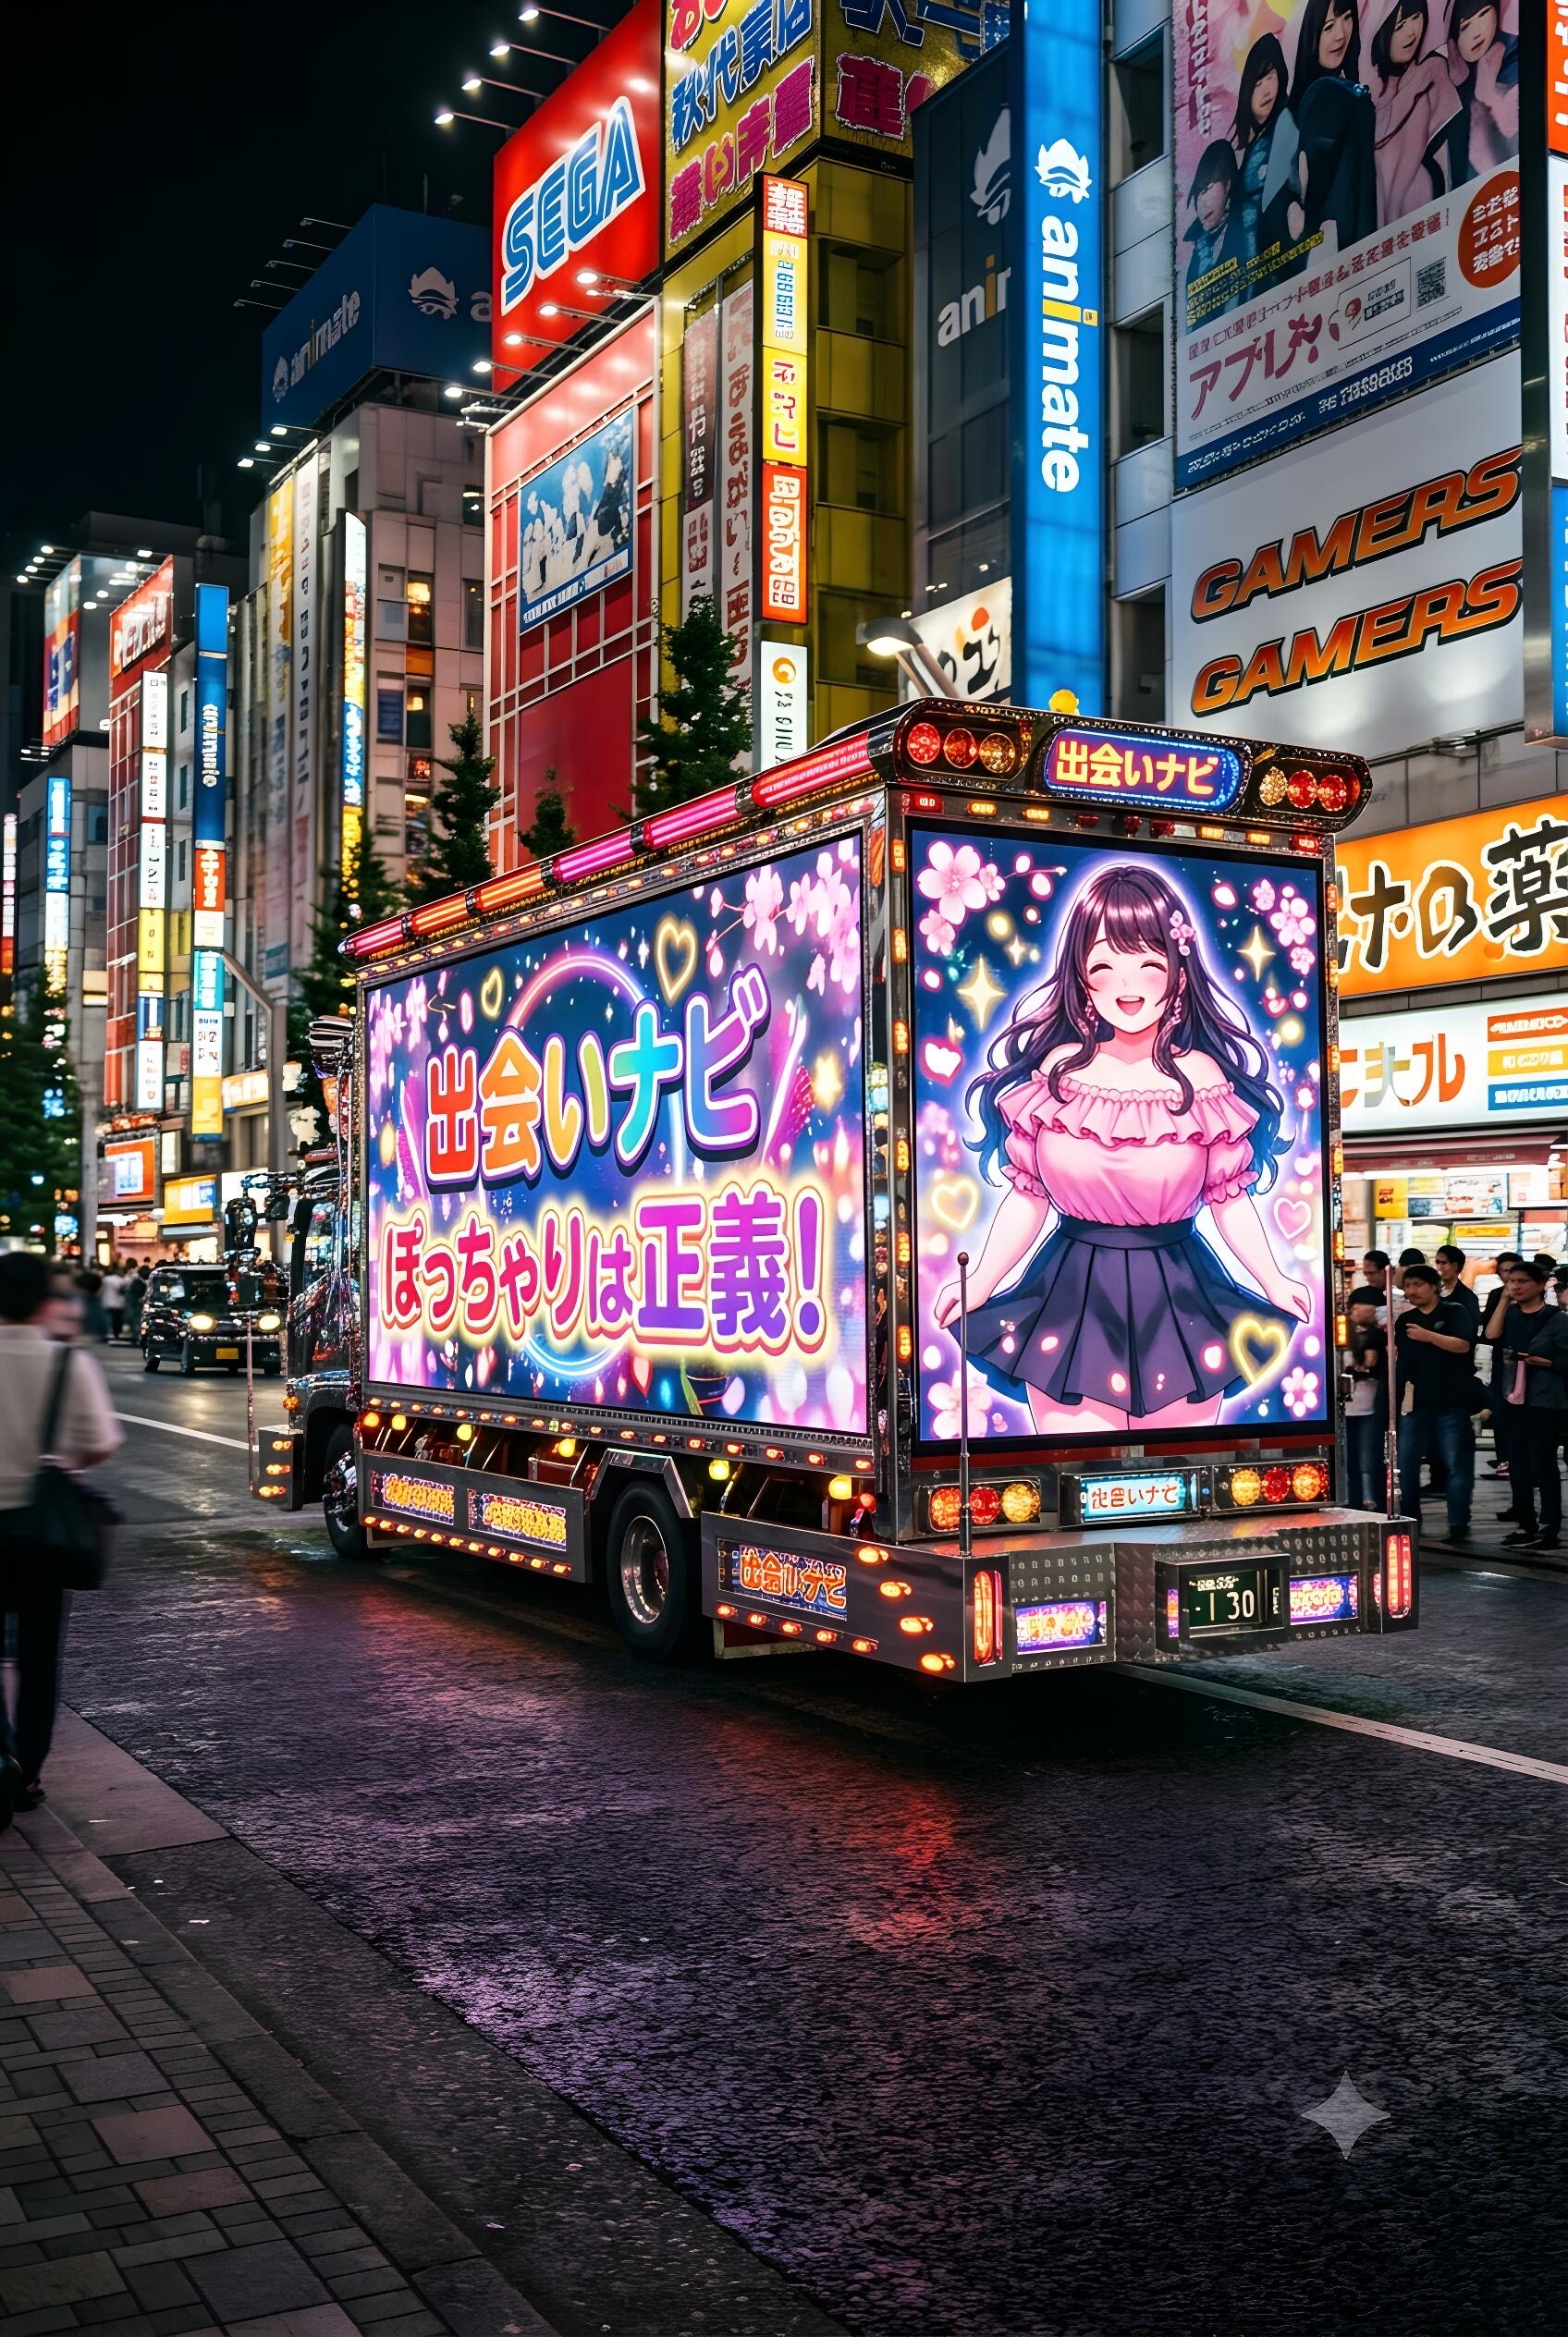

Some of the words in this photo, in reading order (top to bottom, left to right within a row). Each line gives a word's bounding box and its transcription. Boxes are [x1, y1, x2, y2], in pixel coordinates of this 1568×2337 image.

[502, 96, 645, 316] SEGA
[1041, 215, 1098, 493] animate
[1191, 445, 1523, 624] GAMERS
[1191, 559, 1523, 717] GAMERS
[1055, 740, 1219, 796] 出会いナビ
[427, 965, 770, 1187] 出会いナビ
[384, 1180, 827, 1353] ぽっちゃりは正義!
